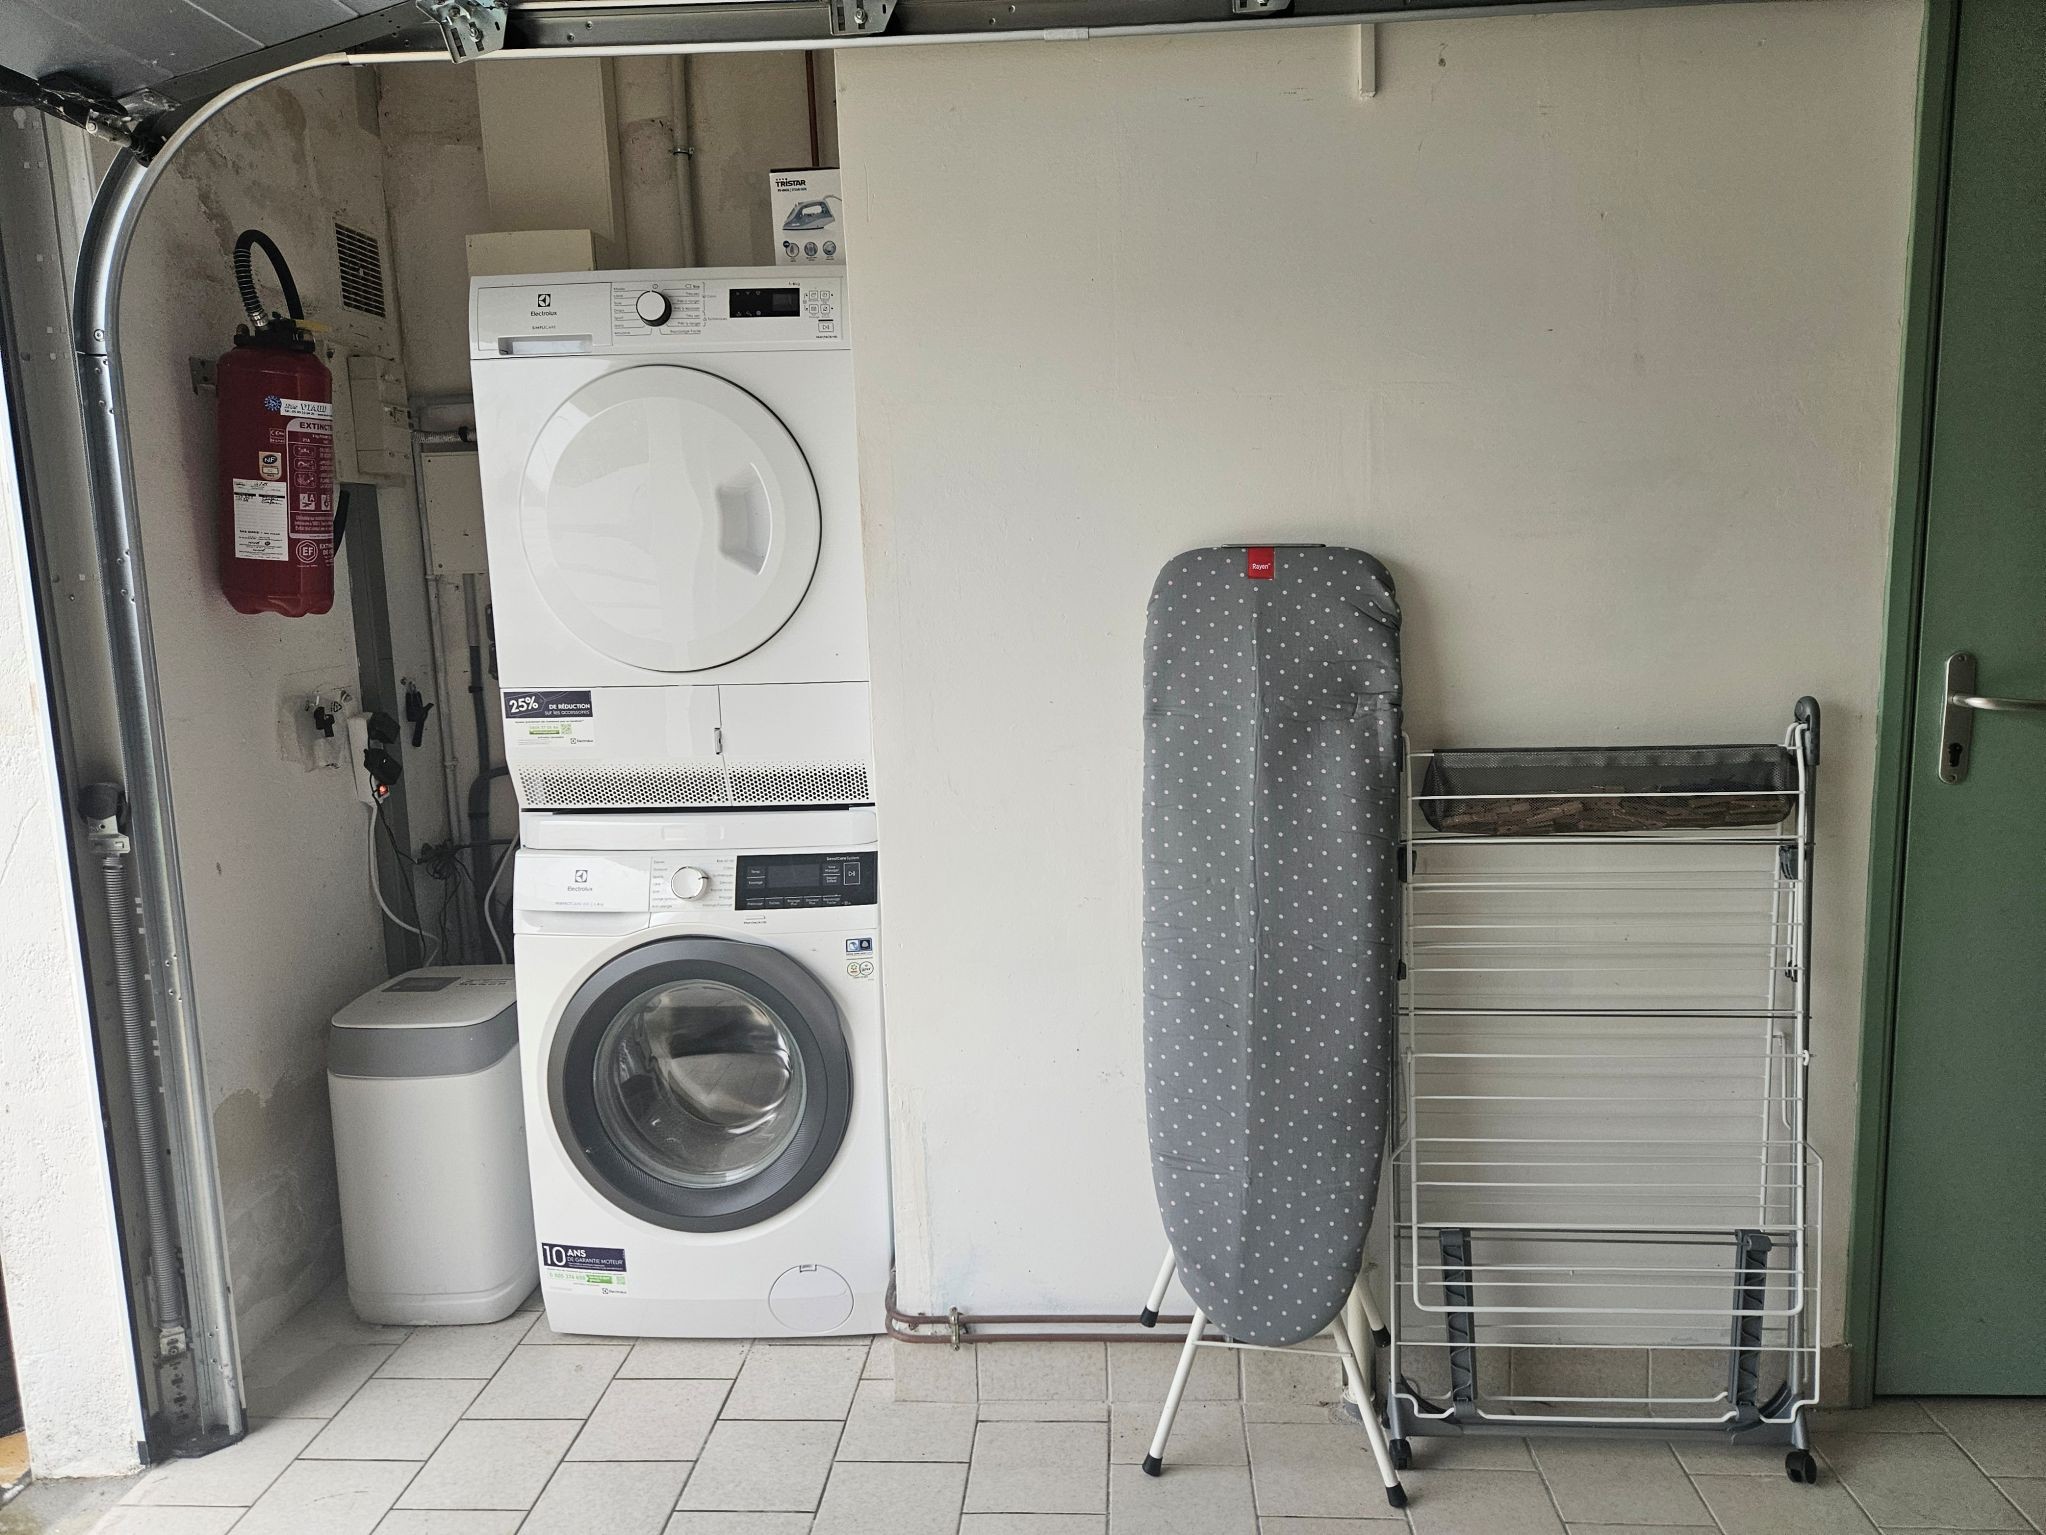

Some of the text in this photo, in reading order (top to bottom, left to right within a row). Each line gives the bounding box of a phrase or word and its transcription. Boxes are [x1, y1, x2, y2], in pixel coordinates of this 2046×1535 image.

[775, 178, 806, 188] TRISTAR
[302, 547, 314, 556] EF
[509, 696, 539, 713] 25%
[543, 1245, 567, 1266] 10
[567, 1249, 587, 1258] ANS
